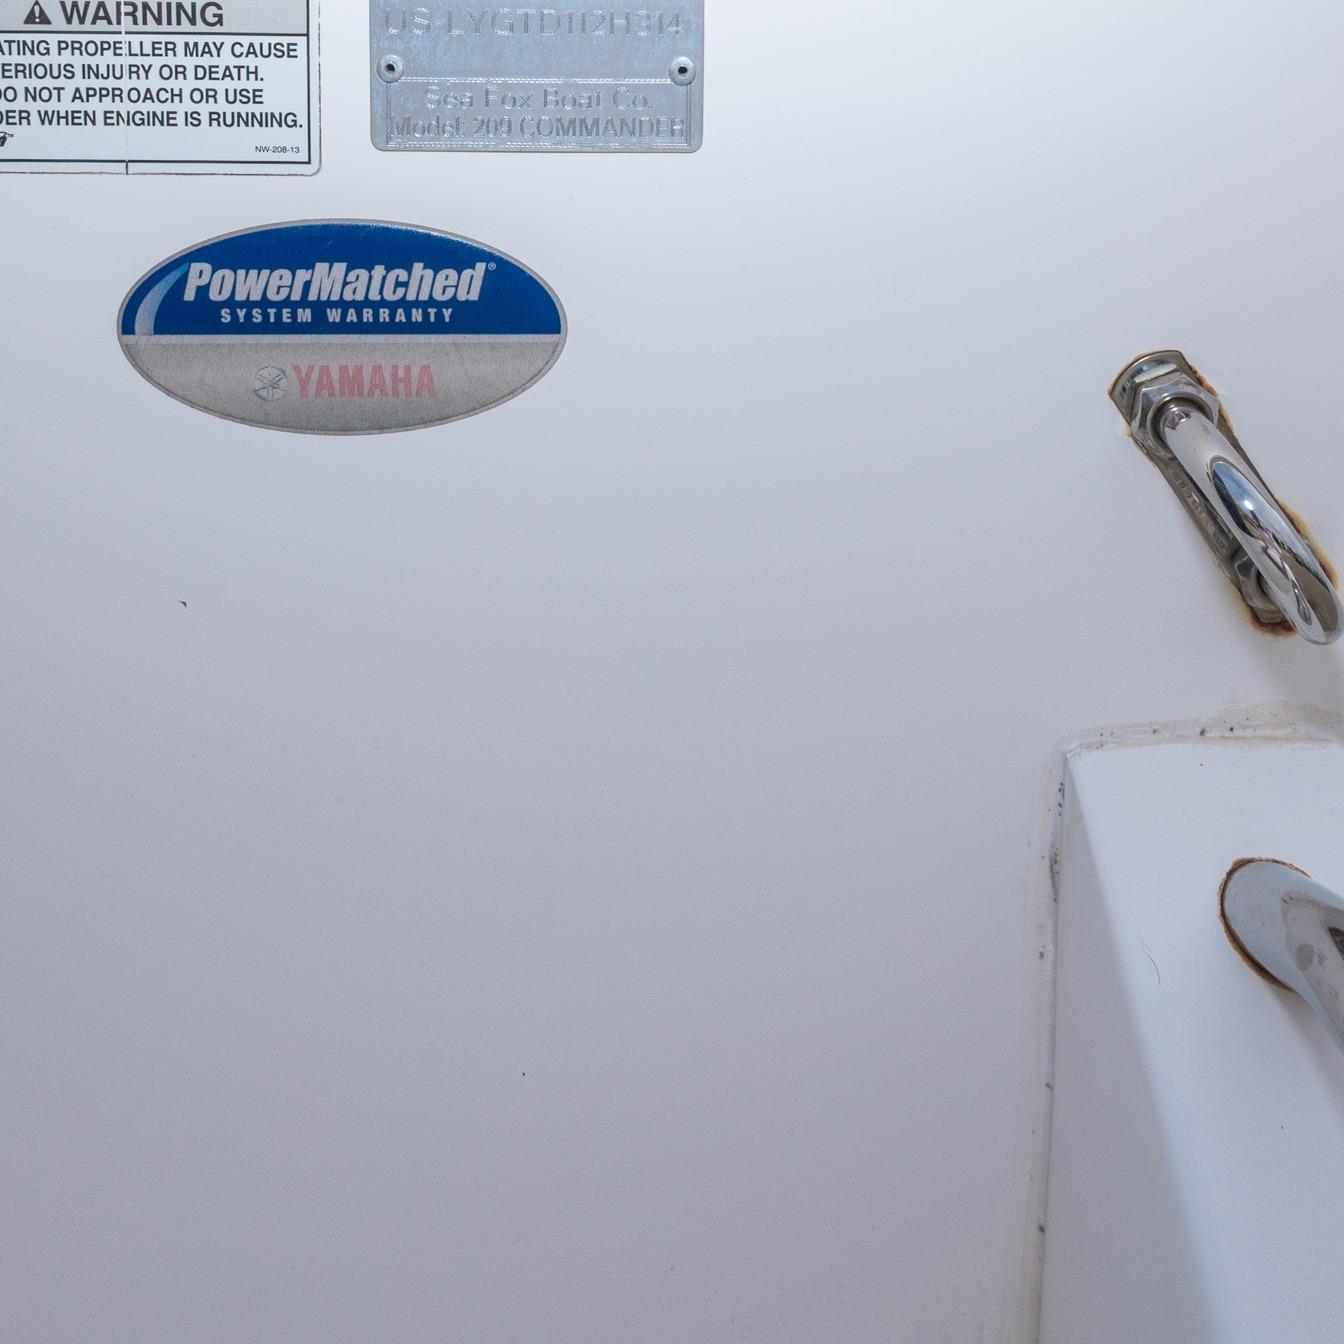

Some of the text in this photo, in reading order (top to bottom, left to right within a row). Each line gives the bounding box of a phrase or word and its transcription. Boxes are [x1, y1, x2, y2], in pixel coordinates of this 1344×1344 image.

[59, 0, 224, 28] WARNING
[57, 39, 177, 58] PROPELLER
[183, 41, 225, 58] MAY
[230, 41, 299, 59] CAUSE
[81, 63, 153, 81] INJURY
[158, 63, 188, 81] OR
[194, 64, 264, 82] DEATH.
[24, 86, 66, 103] NOT
[70, 86, 183, 104] APPROACH
[189, 87, 218, 105] OR
[224, 88, 264, 105] USE
[483, 84, 533, 110] Fox
[543, 86, 603, 110] Boat
[611, 86, 654, 111] Co.
[36, 109, 97, 127] WHEN
[103, 110, 178, 127] ENGINE
[184, 110, 202, 128] IS
[208, 111, 303, 129] RUNNING.
[518, 116, 686, 139] COMMANDER
[255, 145, 300, 154] NW-208-13
[220, 307, 453, 324] SYSTEM WARRANTY
[292, 364, 436, 398] YAMAHA
